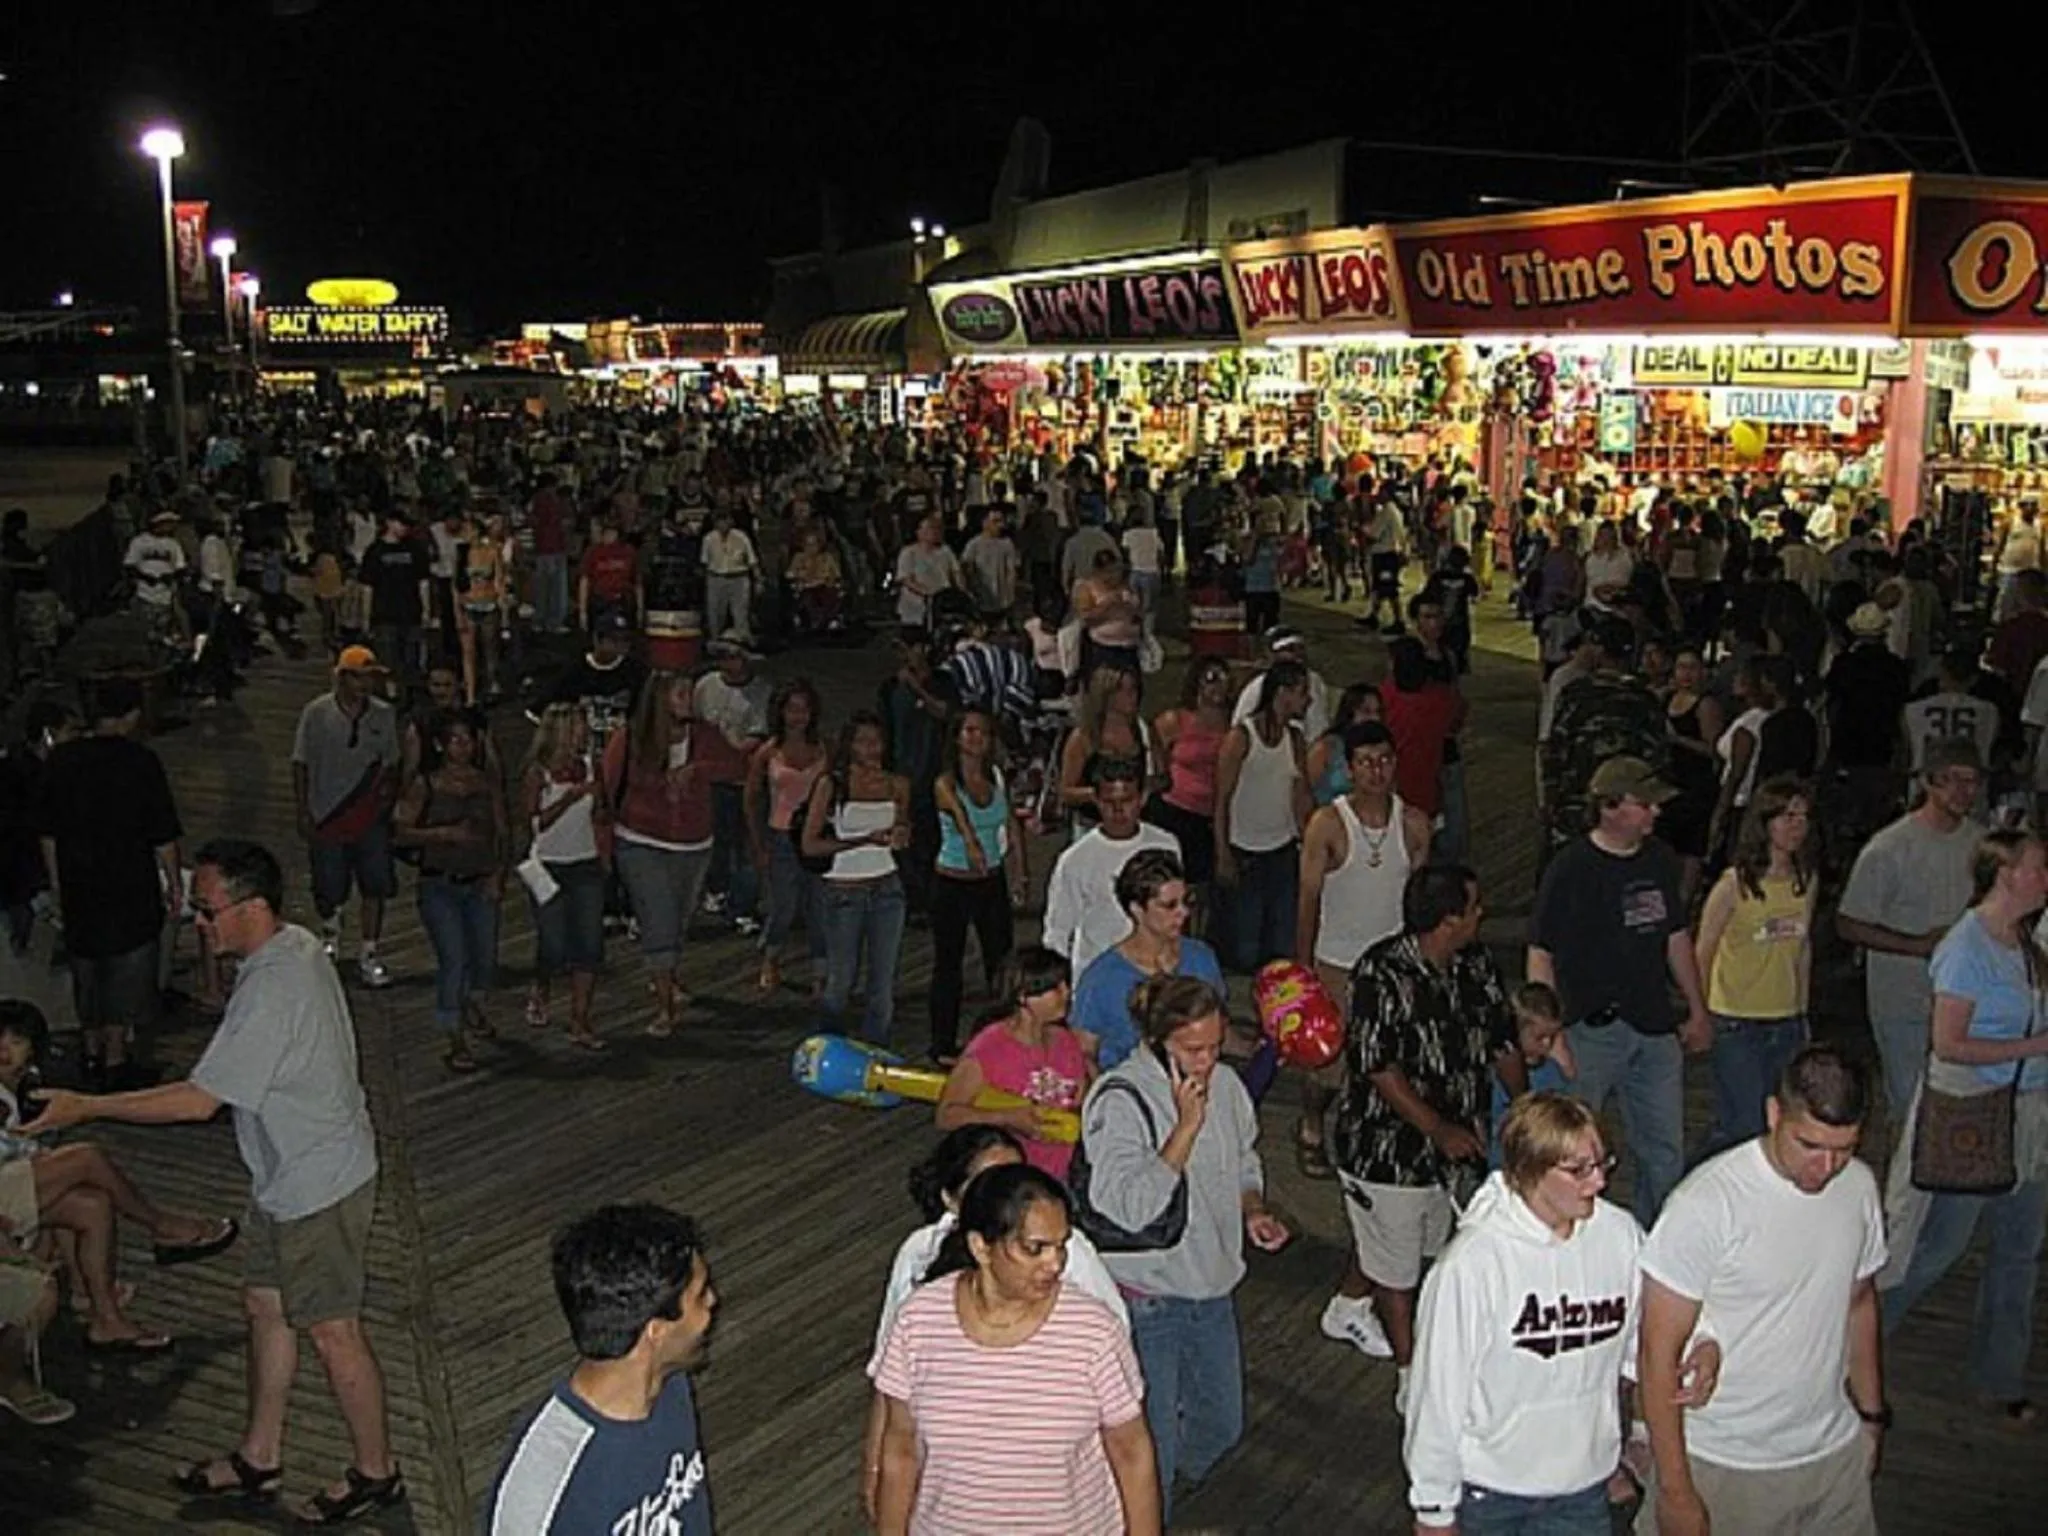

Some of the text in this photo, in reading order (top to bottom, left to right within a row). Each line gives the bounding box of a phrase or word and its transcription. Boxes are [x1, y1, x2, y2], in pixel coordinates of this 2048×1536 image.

[1415, 219, 1885, 305] Old Time Photos
[1311, 246, 1391, 318] LEO'S
[1016, 266, 1223, 339] LUCKY LEO'S
[268, 312, 439, 333] SALT WATER TAFFY
[1643, 346, 1708, 372] DEAL
[1738, 346, 1780, 374] NO
[1781, 347, 1858, 375] DEAL
[1726, 391, 1834, 421] ITALIAN ICE
[1924, 706, 1976, 743] 36
